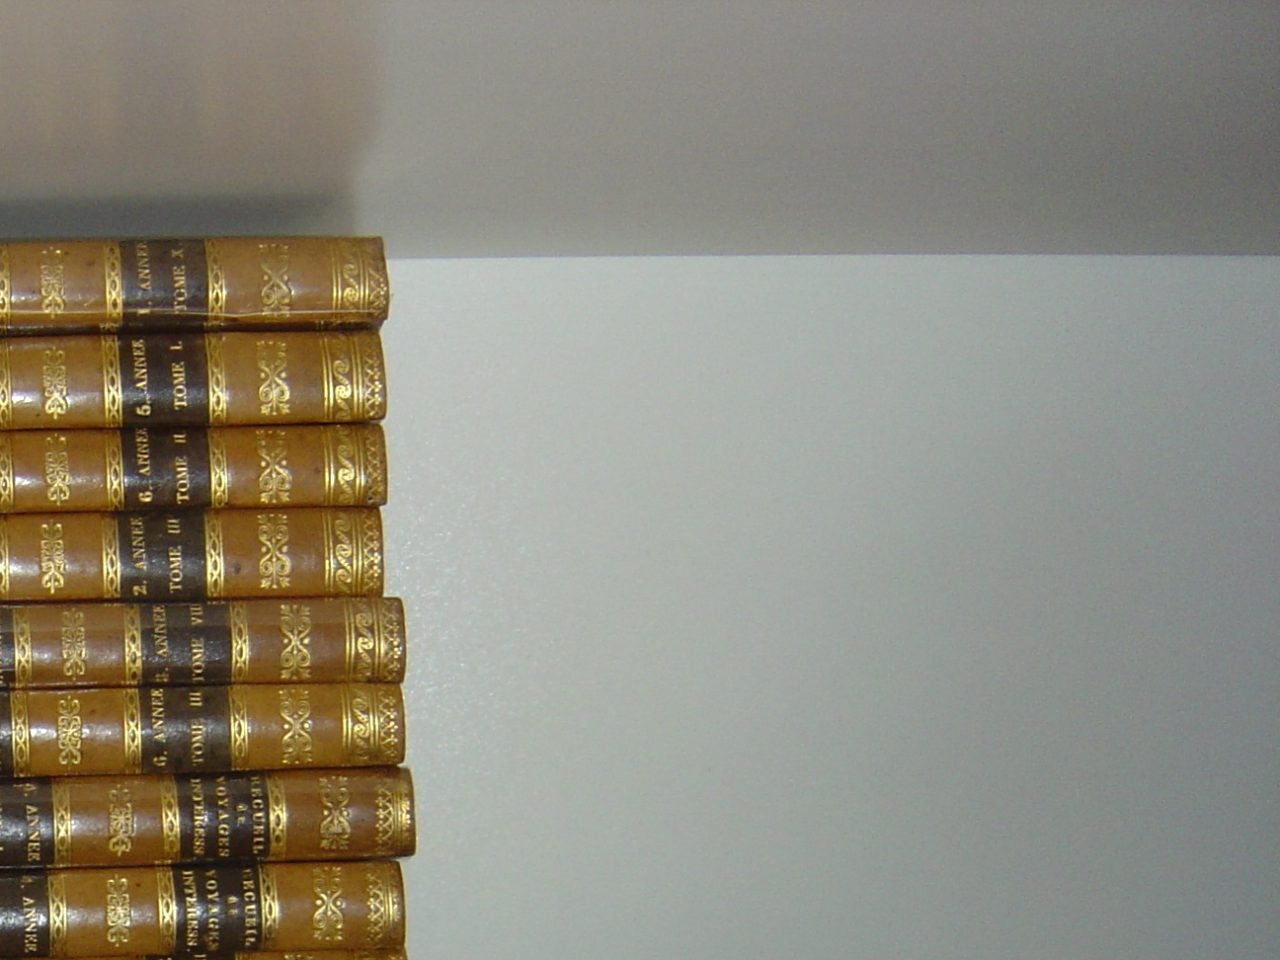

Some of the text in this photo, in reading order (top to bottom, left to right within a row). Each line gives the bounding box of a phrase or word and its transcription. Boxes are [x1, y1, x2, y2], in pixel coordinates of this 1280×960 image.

[172, 265, 187, 314] TOME
[131, 339, 148, 391] ANNEE
[171, 361, 188, 410] TOME
[135, 428, 150, 476] ANNEE
[175, 456, 190, 504] TOME
[130, 517, 147, 570] ANNEE
[167, 545, 183, 593] TOME
[152, 605, 168, 657] ANNEE
[150, 688, 165, 743] ANNEE
[190, 719, 204, 766] TOME
[26, 805, 40, 861] ANNEE
[22, 897, 37, 952] ANNEE
[205, 870, 220, 951] VOYAGES
